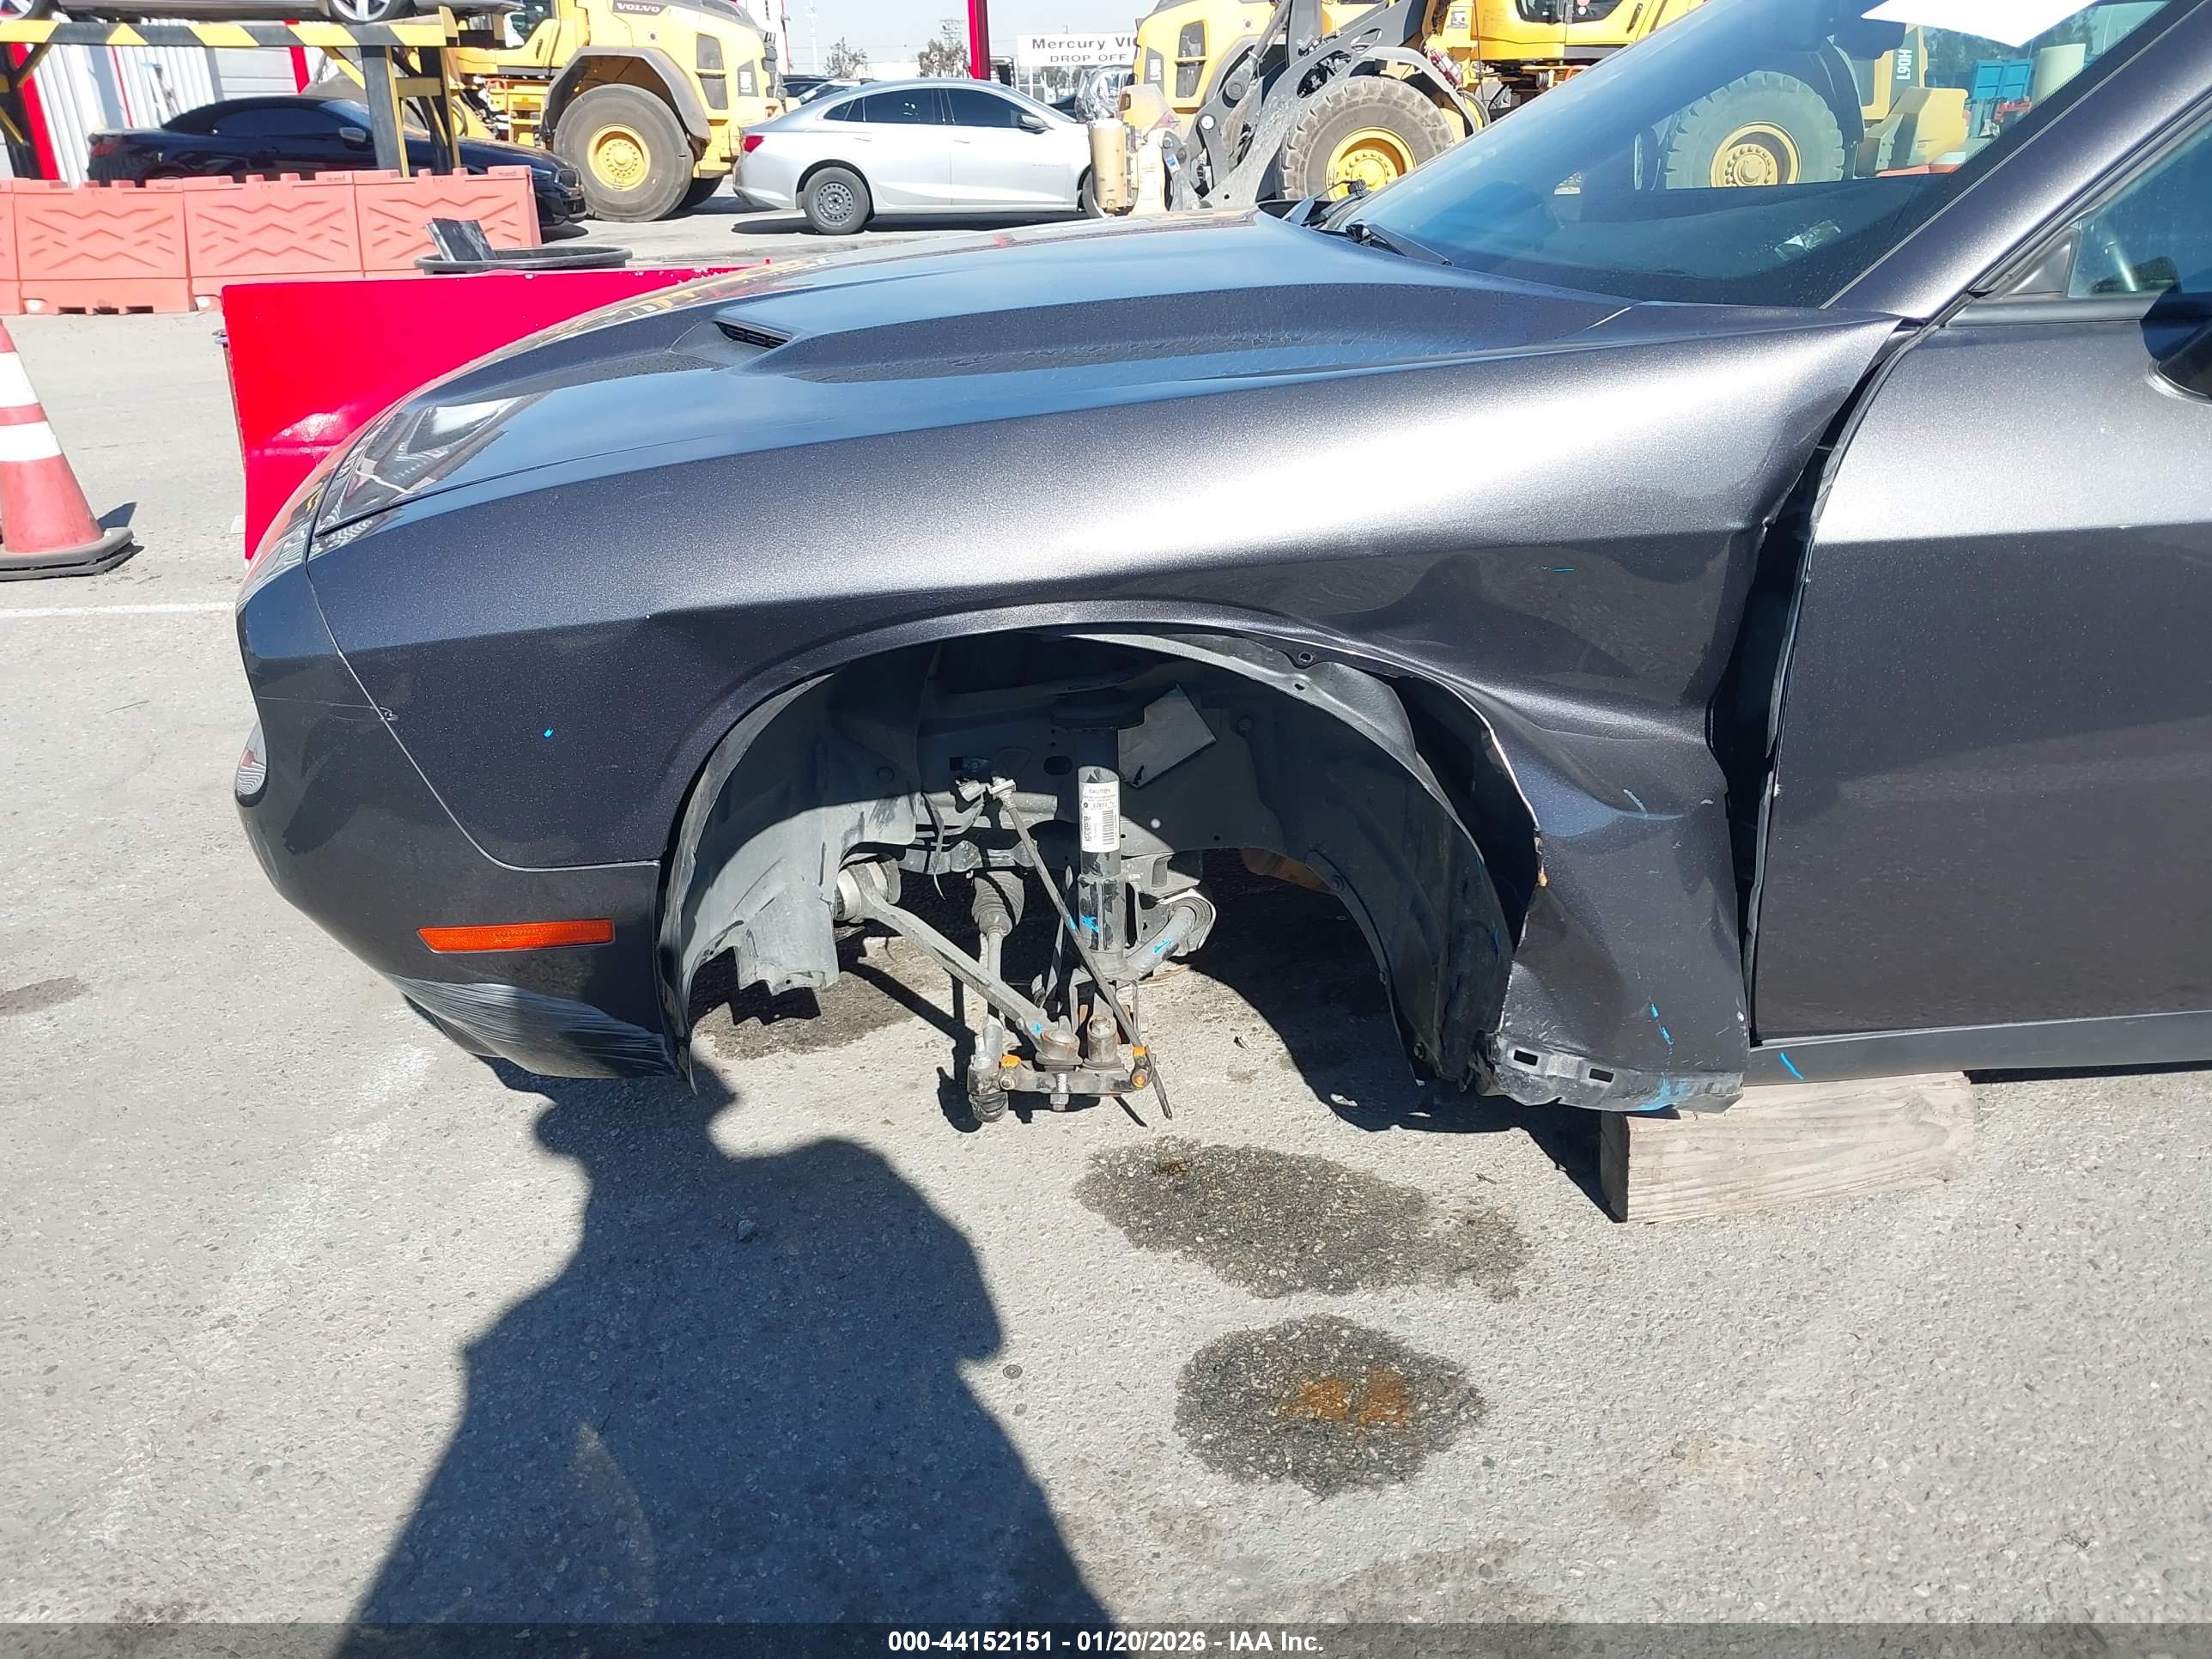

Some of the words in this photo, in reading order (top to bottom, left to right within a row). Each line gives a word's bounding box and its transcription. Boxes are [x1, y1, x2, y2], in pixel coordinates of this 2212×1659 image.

[617, 3, 660, 13] VOLVO
[1032, 39, 1106, 50] Mercury
[1050, 54, 1091, 63] DROP
[1098, 53, 1127, 62] OFF
[1896, 49, 1912, 80] L90H
